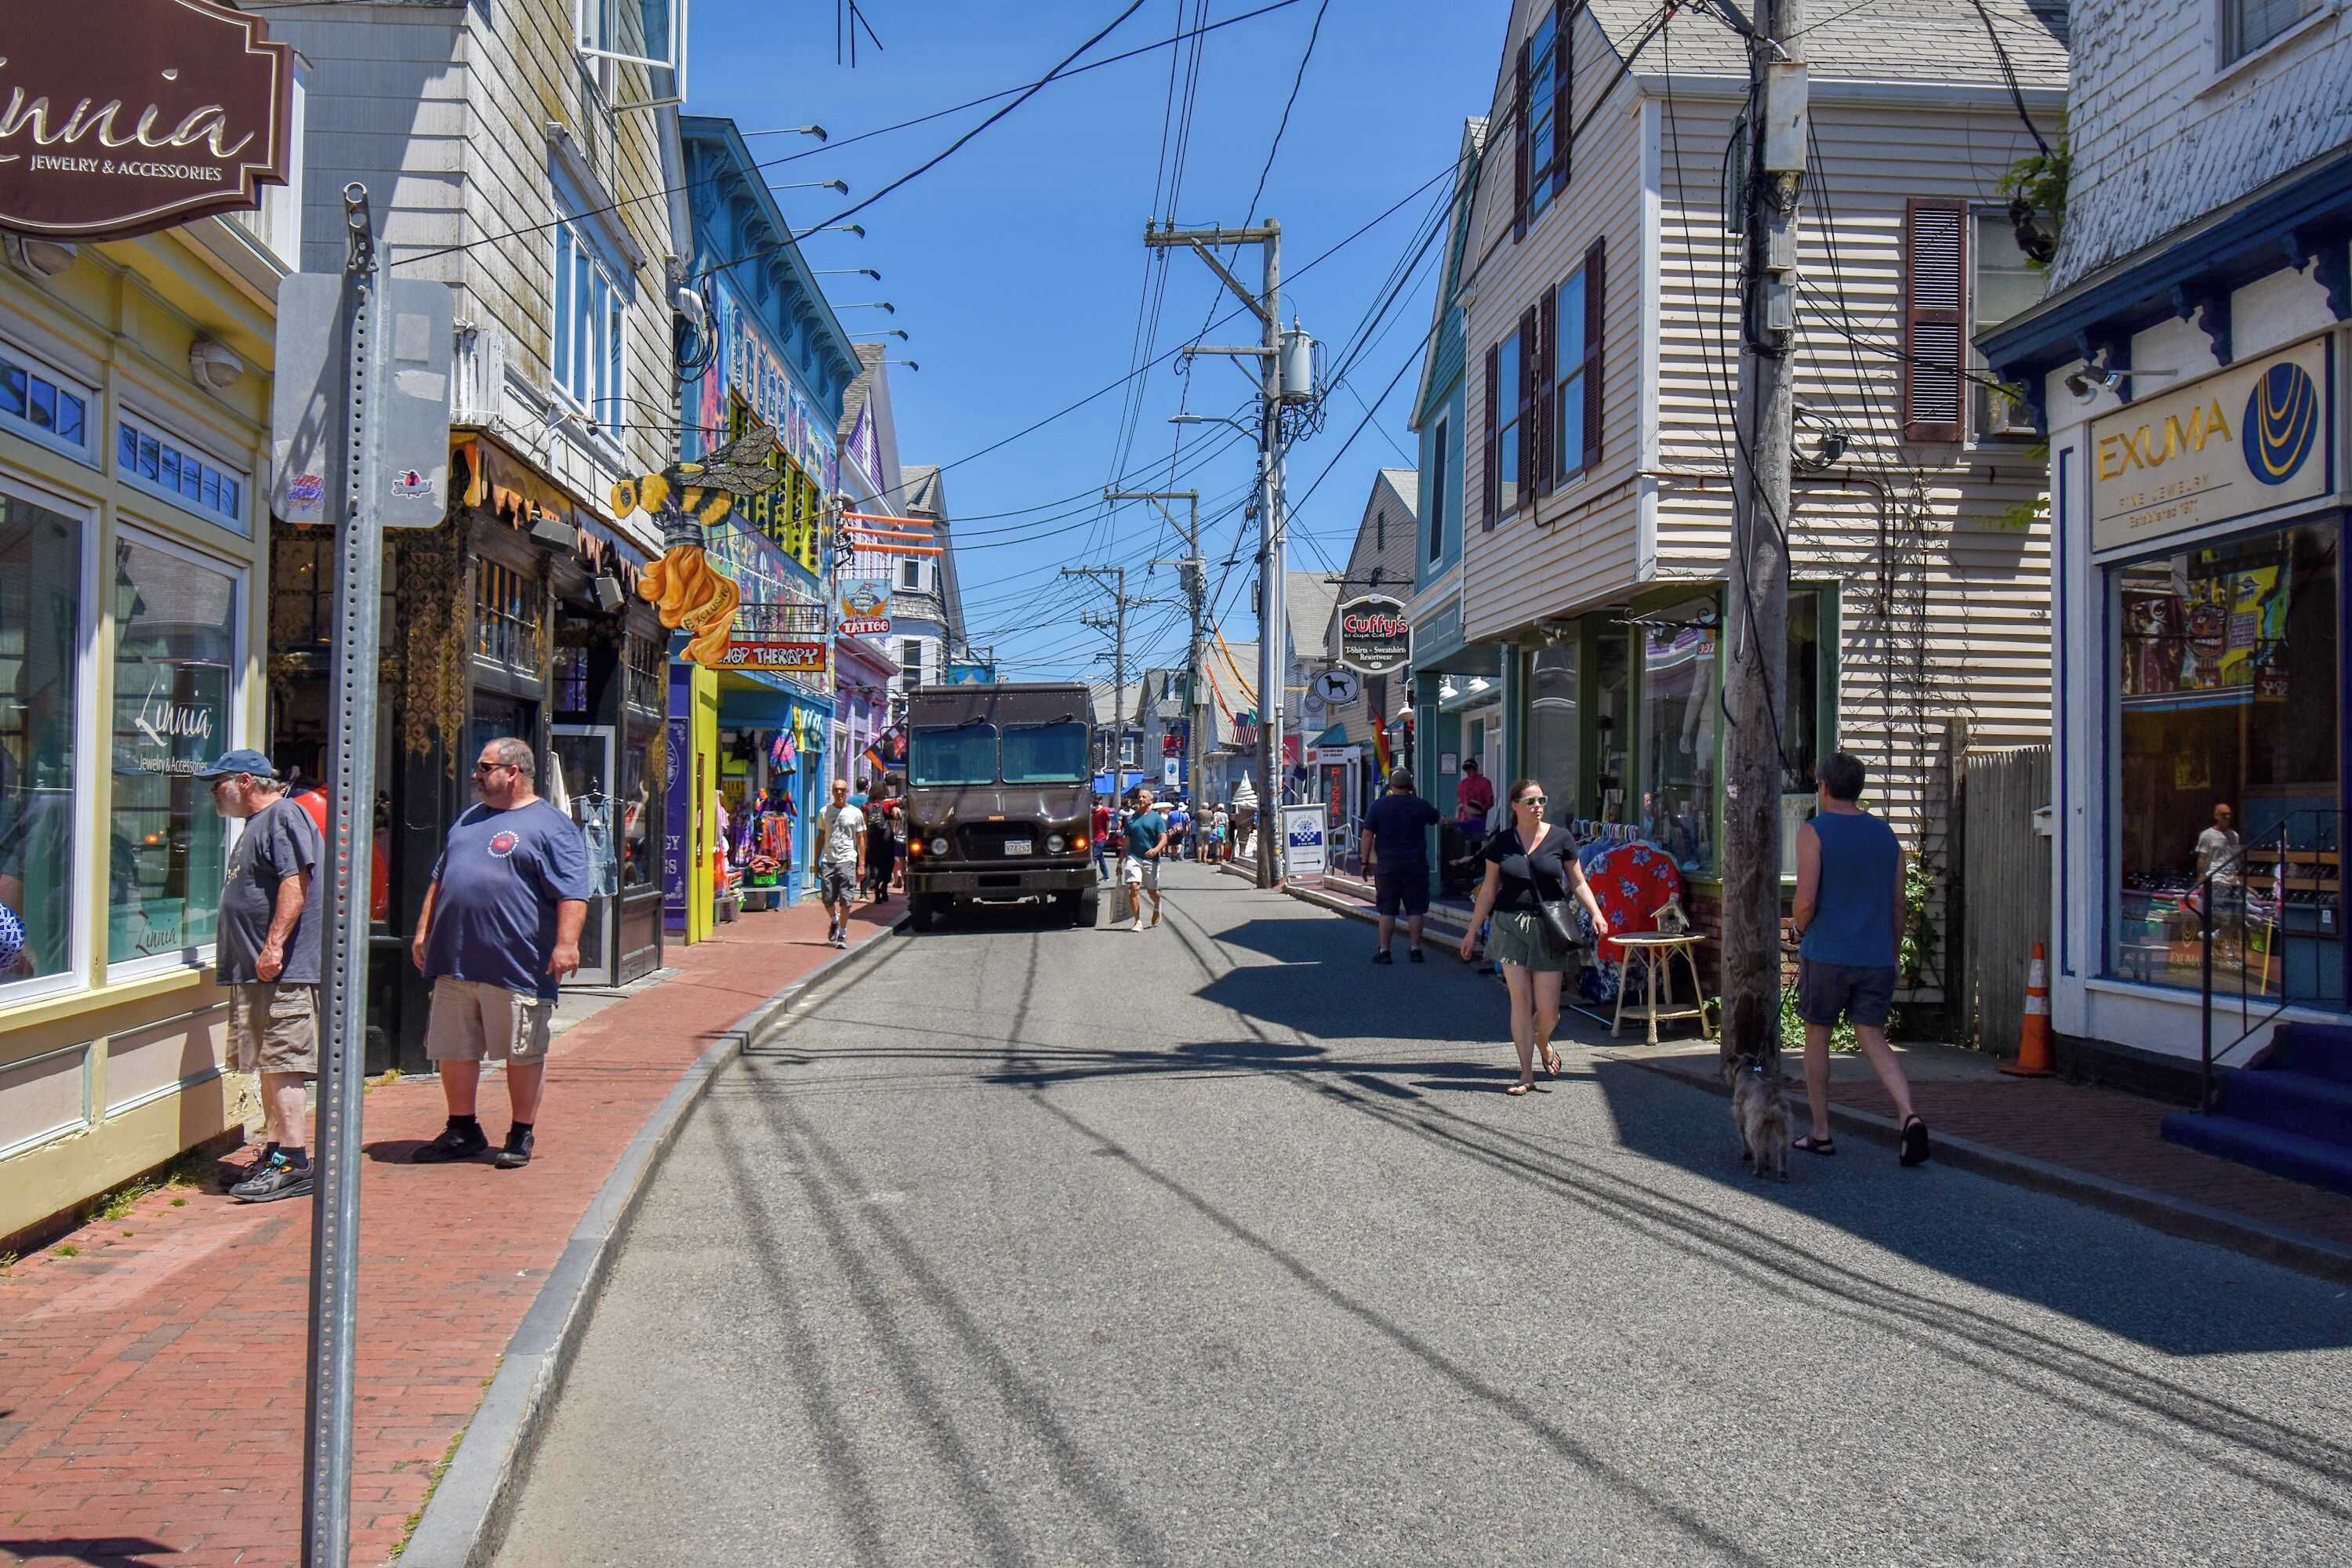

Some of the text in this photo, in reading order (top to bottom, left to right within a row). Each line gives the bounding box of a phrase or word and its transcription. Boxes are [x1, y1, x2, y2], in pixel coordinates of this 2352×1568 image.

[0, 56, 255, 162] nnia
[31, 154, 223, 182] JEWELRY & ACCESSORIES
[2098, 397, 2234, 482] EXUMA
[2119, 492, 2145, 510] FINE
[843, 621, 889, 633] TATTOO
[1344, 614, 1409, 637] Cuffy's
[753, 647, 818, 666] THERAPY
[1345, 645, 1406, 654] T-Shirts Sweatshirts
[139, 753, 165, 777] Jewelry
[1331, 768, 1341, 815] PIZZA
